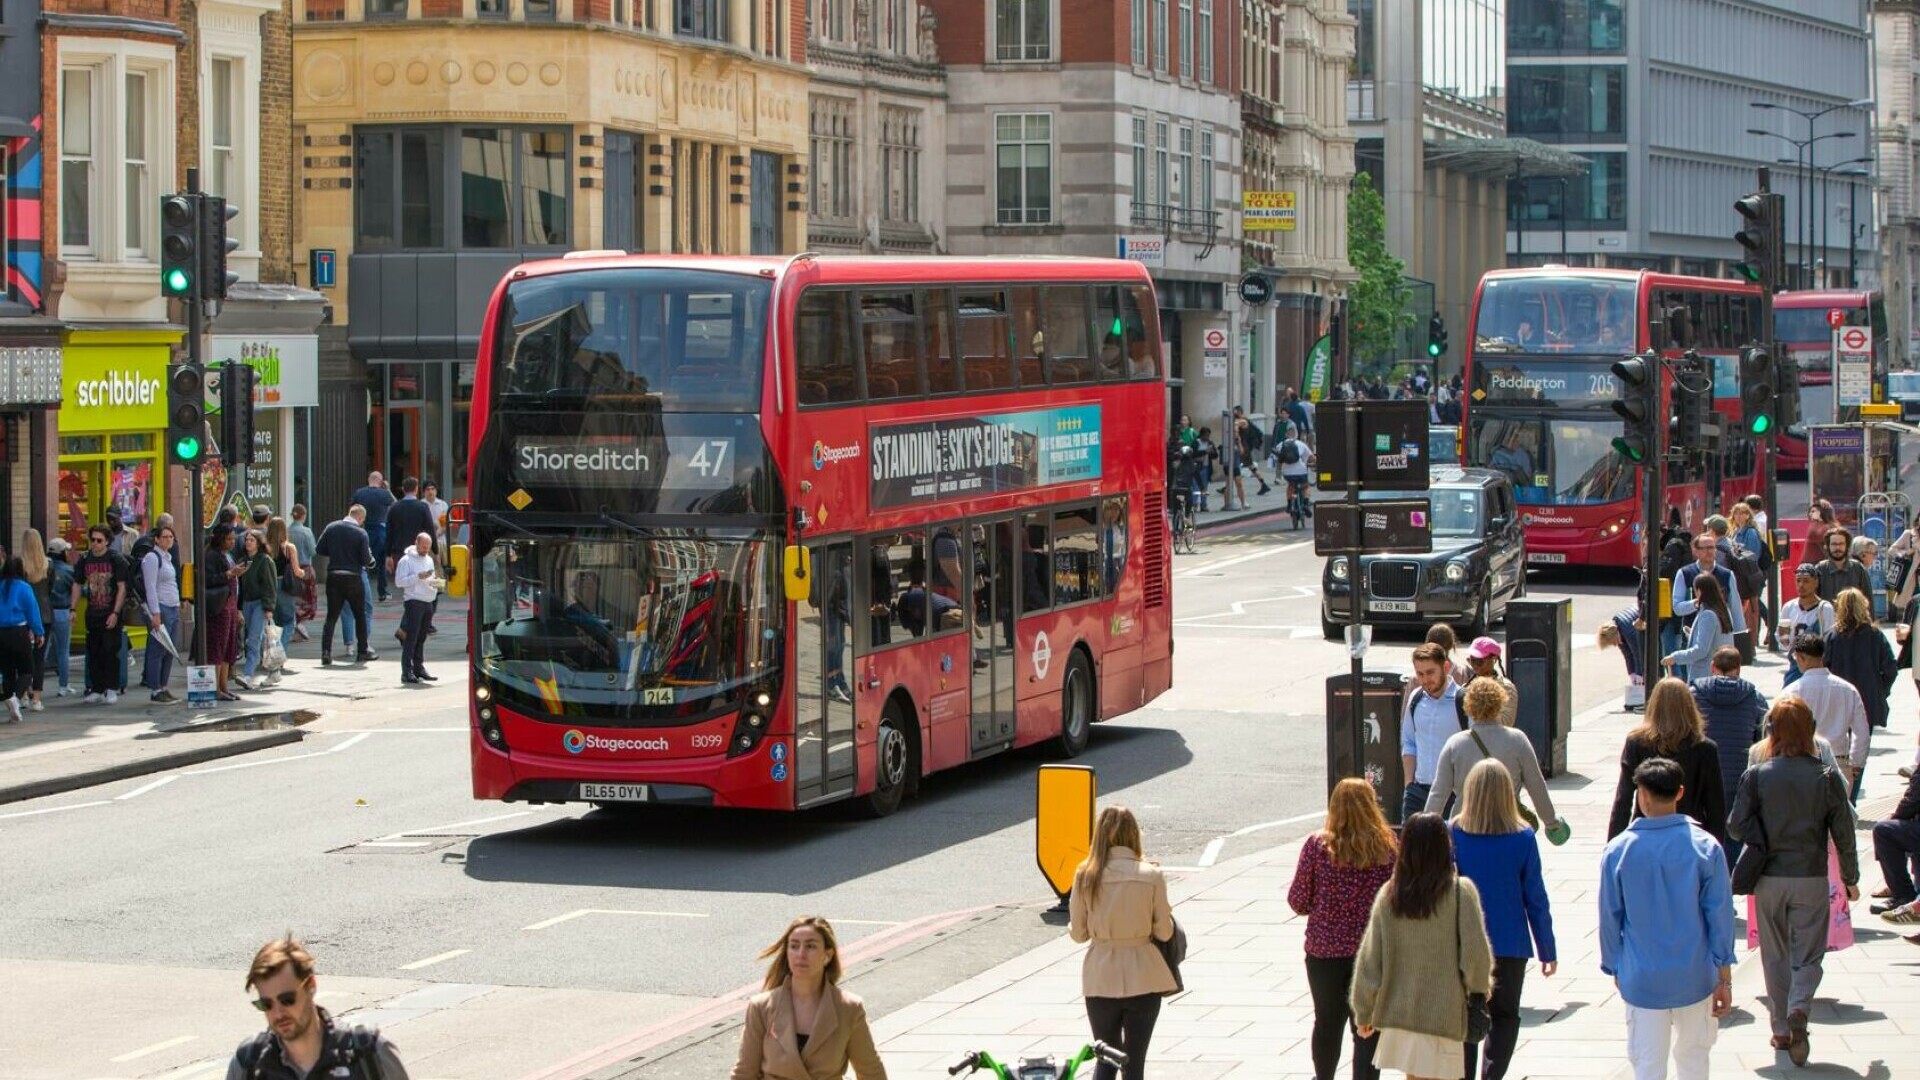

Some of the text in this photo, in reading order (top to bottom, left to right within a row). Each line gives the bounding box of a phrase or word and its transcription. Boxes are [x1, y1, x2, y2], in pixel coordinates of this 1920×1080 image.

[1246, 200, 1292, 208] TO LET
[1244, 209, 1264, 217] PEARL
[1129, 241, 1161, 249] TESCO
[1129, 252, 1161, 261] express
[1831, 311, 1840, 324] F
[78, 370, 160, 407] scribbler
[1492, 374, 1614, 395] Paddington 205
[823, 442, 860, 464] Stagecoach
[873, 430, 941, 481] STANDING
[949, 426, 982, 472] SKY'S
[984, 422, 1015, 467] EDGE
[520, 440, 729, 477] Shoreditch 47
[247, 467, 272, 482] for your
[247, 480, 272, 499] buck
[1532, 515, 1574, 524] Stagecoach
[1374, 602, 1393, 611] KE19
[646, 690, 671, 703] 214
[585, 734, 722, 752] Stagecoach 13099
[585, 786, 643, 799] BL65 OYV
